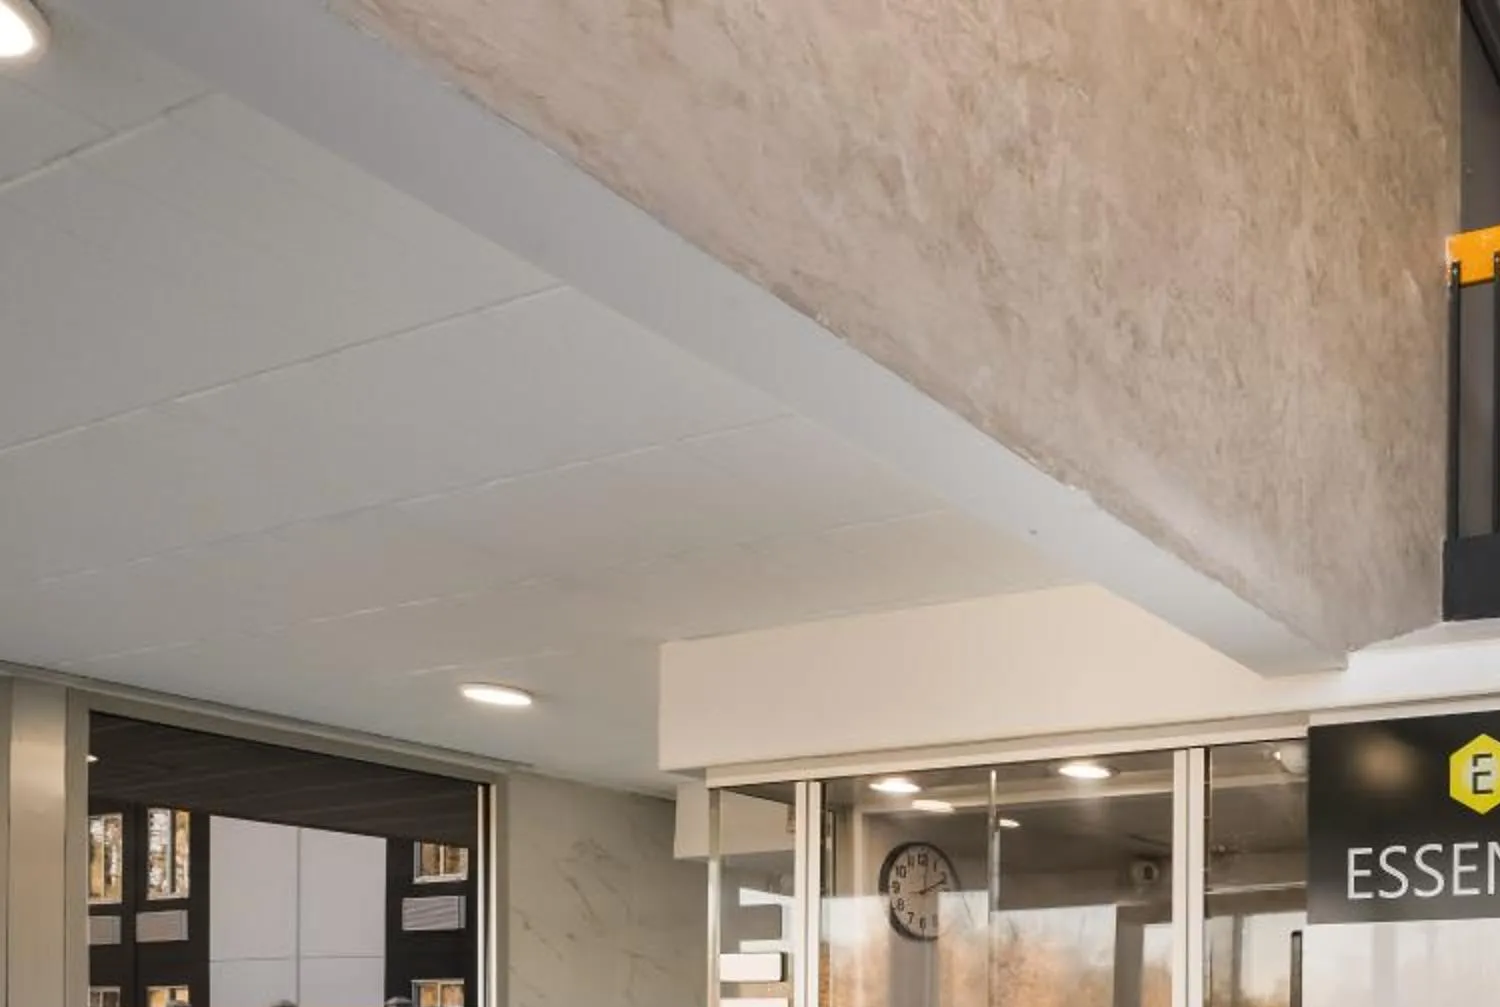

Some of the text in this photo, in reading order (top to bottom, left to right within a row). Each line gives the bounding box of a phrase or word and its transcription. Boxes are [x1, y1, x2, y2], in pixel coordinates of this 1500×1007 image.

[1471, 753, 1494, 795] E
[896, 865, 907, 878] 10
[891, 881, 900, 894] 9
[897, 898, 905, 911] 8
[907, 912, 915, 924] 7
